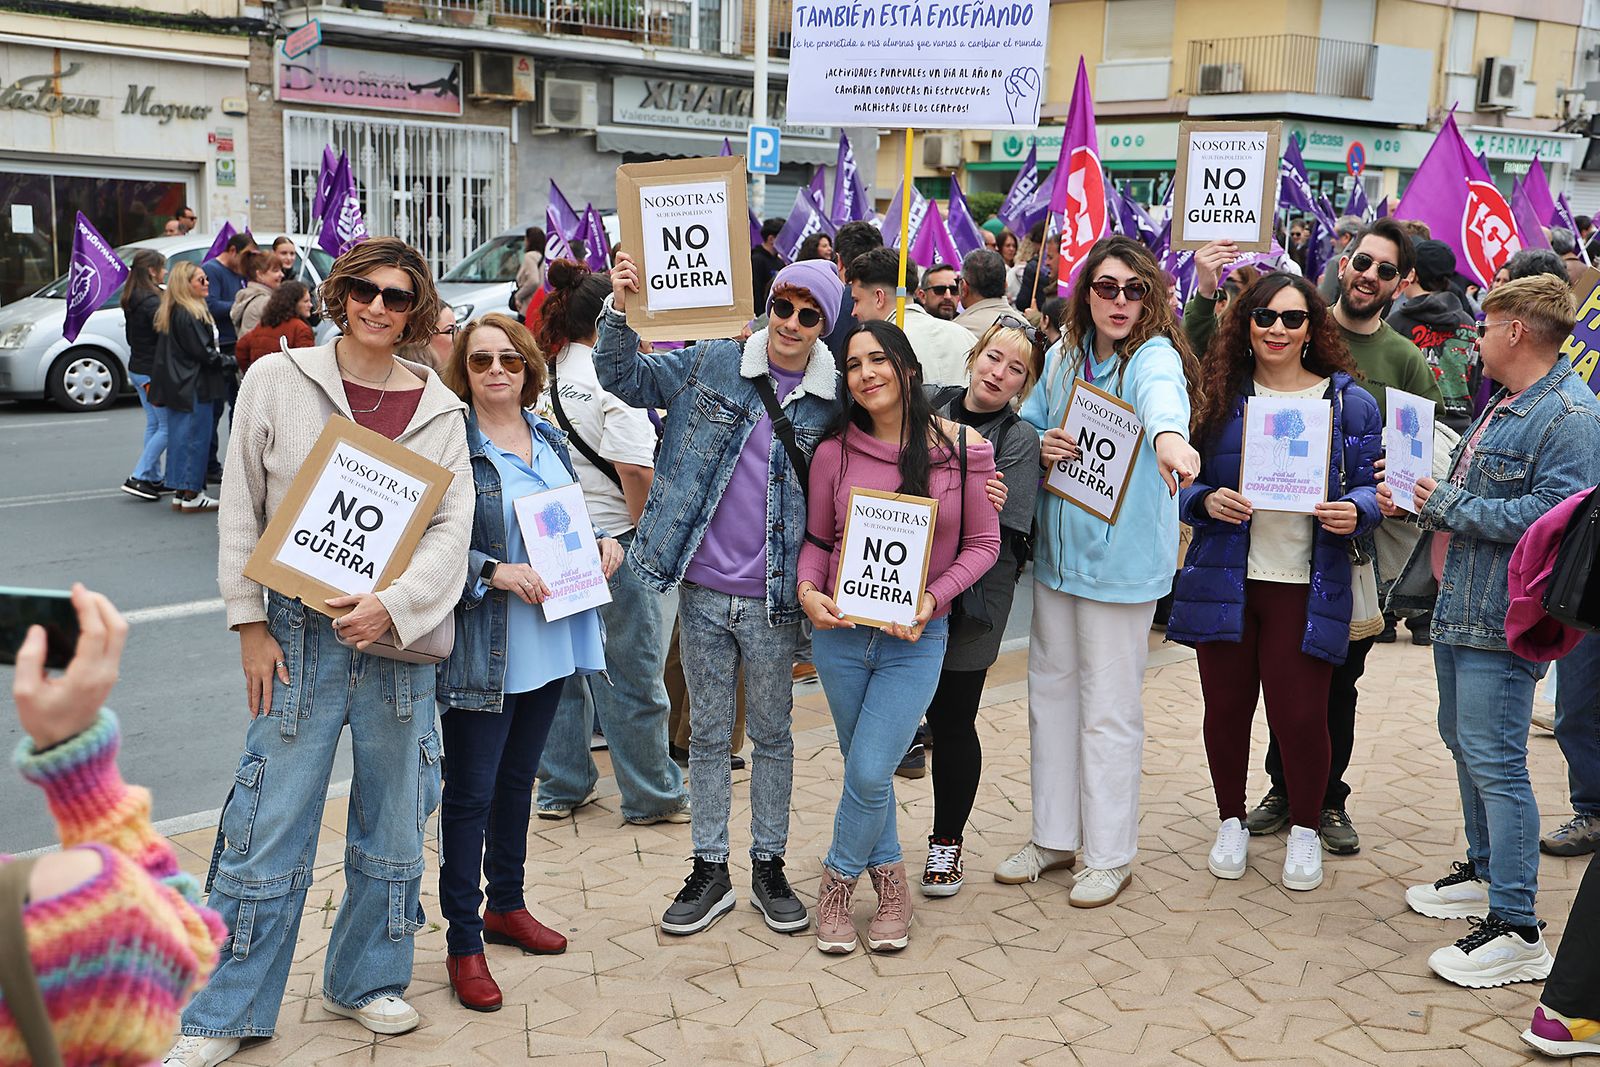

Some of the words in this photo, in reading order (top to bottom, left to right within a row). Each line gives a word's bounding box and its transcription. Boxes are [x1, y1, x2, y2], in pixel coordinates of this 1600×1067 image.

[804, 37, 814, 48] he
[816, 38, 858, 51] prometido
[868, 39, 880, 47] mis
[883, 37, 914, 47] alumnas
[917, 40, 931, 51] que
[968, 38, 1000, 48] cambiar
[1003, 37, 1012, 47] el
[1015, 38, 1043, 47] mundo
[960, 69, 968, 78] AL
[122, 84, 212, 125] Moguer
[902, 103, 911, 112] DE
[619, 108, 679, 124] Valenciana
[686, 116, 717, 128] Costa
[720, 117, 732, 128] de
[755, 131, 774, 168] P
[1192, 140, 1265, 151] NOSOTRAS
[1488, 135, 1562, 157] FARMACIA
[1203, 168, 1246, 190] NO
[644, 192, 724, 208] NOSOTRAS
[1204, 193, 1215, 206] A
[1223, 193, 1241, 206] LA
[1188, 209, 1256, 223] GUERRA
[79, 222, 121, 272] www.ugt.es
[662, 224, 709, 251] NO
[667, 255, 680, 270] A
[687, 252, 708, 269] LA
[650, 270, 728, 290] GUERRA
[1075, 395, 1140, 436] NOSOTRAS
[1081, 412, 1101, 426] SUJETOS
[1077, 426, 1116, 461] NO
[1075, 450, 1084, 466] A
[1089, 457, 1106, 478] LA
[333, 452, 420, 503] NOSOTRAS
[340, 474, 367, 491] SUJETOS
[1056, 460, 1114, 500] GUERRA
[1245, 482, 1322, 495] COMPAÑERAS
[328, 490, 384, 532] NO
[854, 504, 928, 527] NOSOTRAS
[320, 519, 336, 537] A
[342, 528, 366, 552] LA
[863, 522, 886, 530] SUJETOS
[294, 529, 376, 579] GUERRA
[862, 537, 907, 566] NO
[862, 564, 874, 580] A
[881, 567, 900, 584] LA
[843, 580, 913, 606] GUERRA
